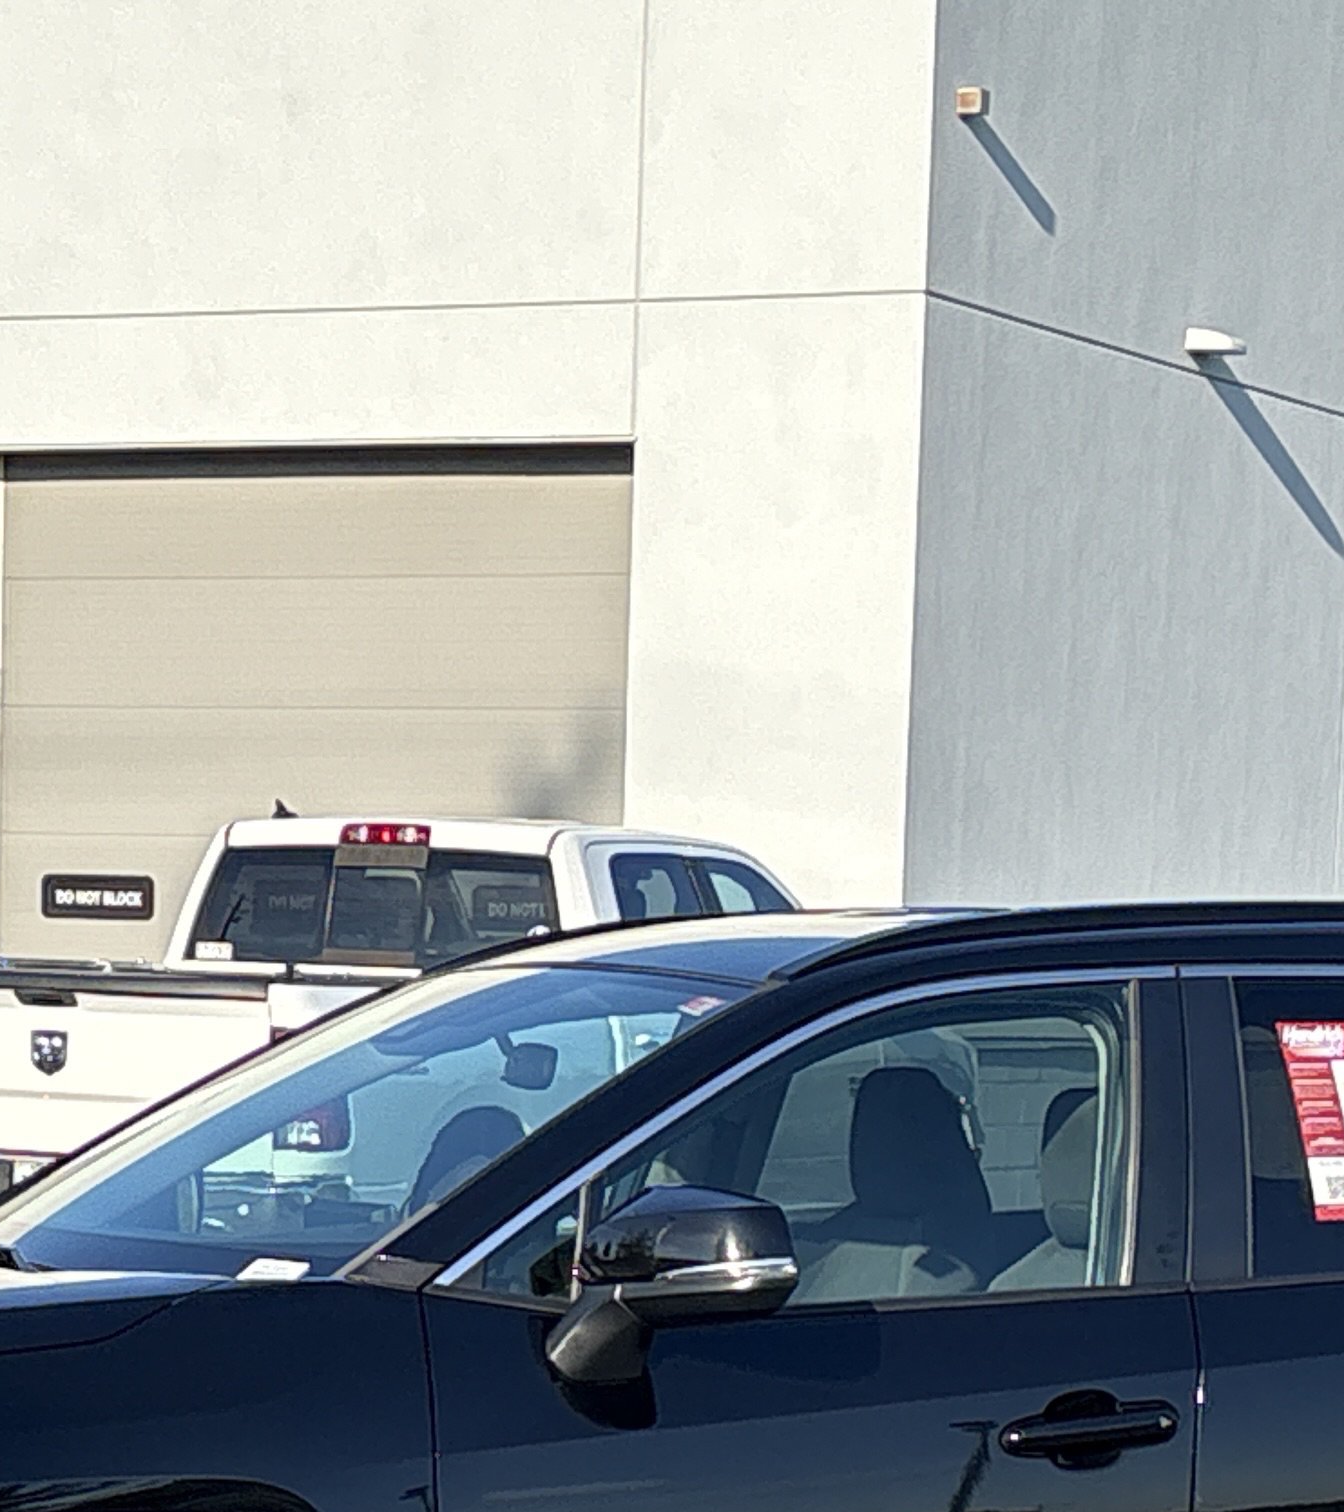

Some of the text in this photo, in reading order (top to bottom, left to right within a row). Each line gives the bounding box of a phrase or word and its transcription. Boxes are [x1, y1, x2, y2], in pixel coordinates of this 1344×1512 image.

[55, 889, 144, 907] DO NOT BLOCK
[487, 902, 506, 917] DO
[510, 903, 538, 918] NOT
